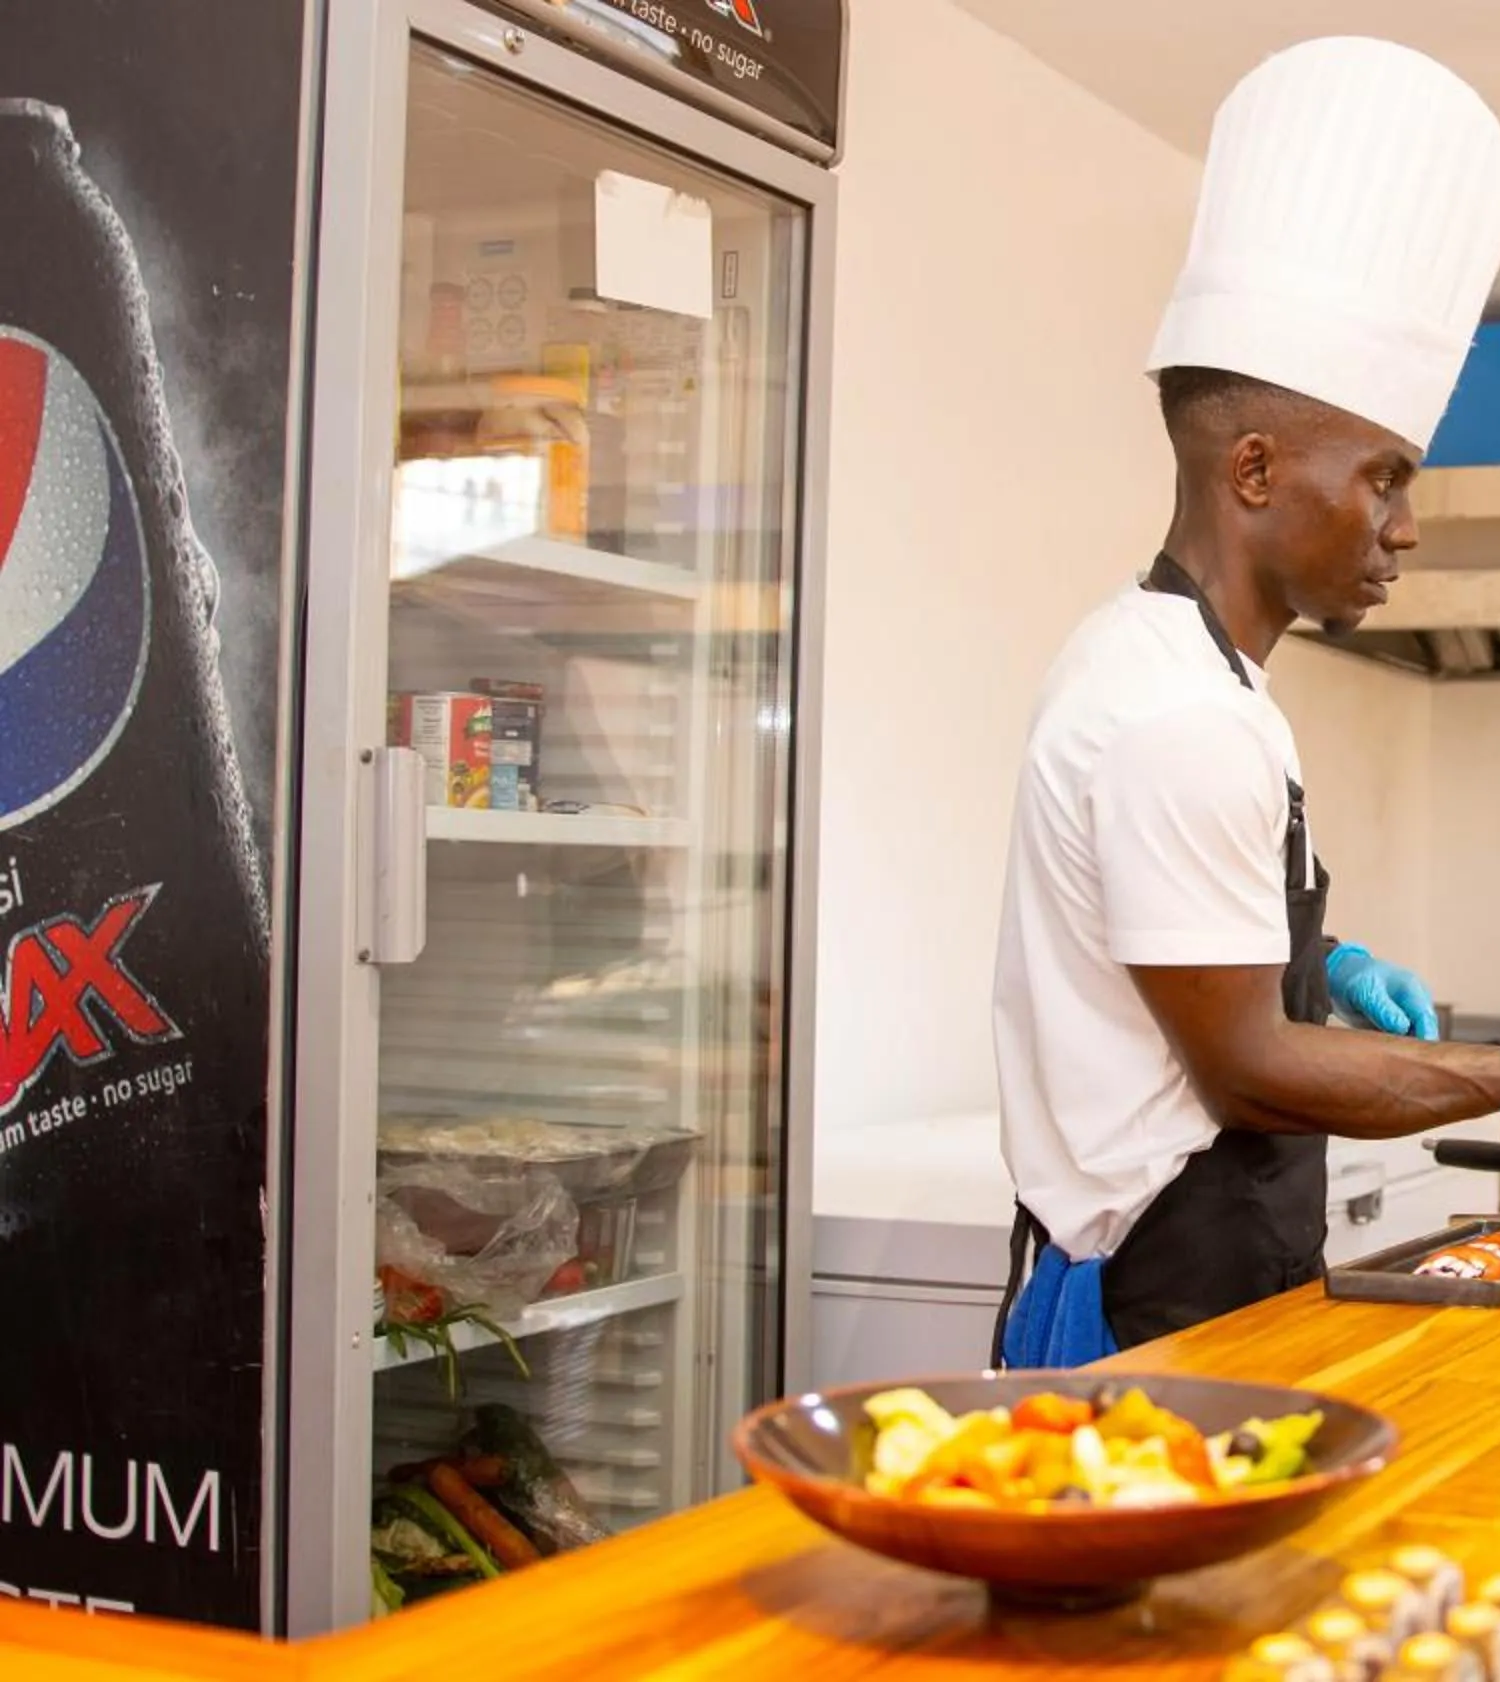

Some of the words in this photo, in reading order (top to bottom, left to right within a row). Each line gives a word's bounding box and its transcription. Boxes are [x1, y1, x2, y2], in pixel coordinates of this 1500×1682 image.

[631, 0, 677, 34] taste
[691, 28, 713, 54] no
[717, 43, 765, 80] sugar
[0, 882, 185, 1116] AX
[28, 1095, 87, 1136] taste
[103, 1079, 132, 1108] no
[136, 1060, 193, 1095] sugar
[3, 1443, 220, 1552] MUM
